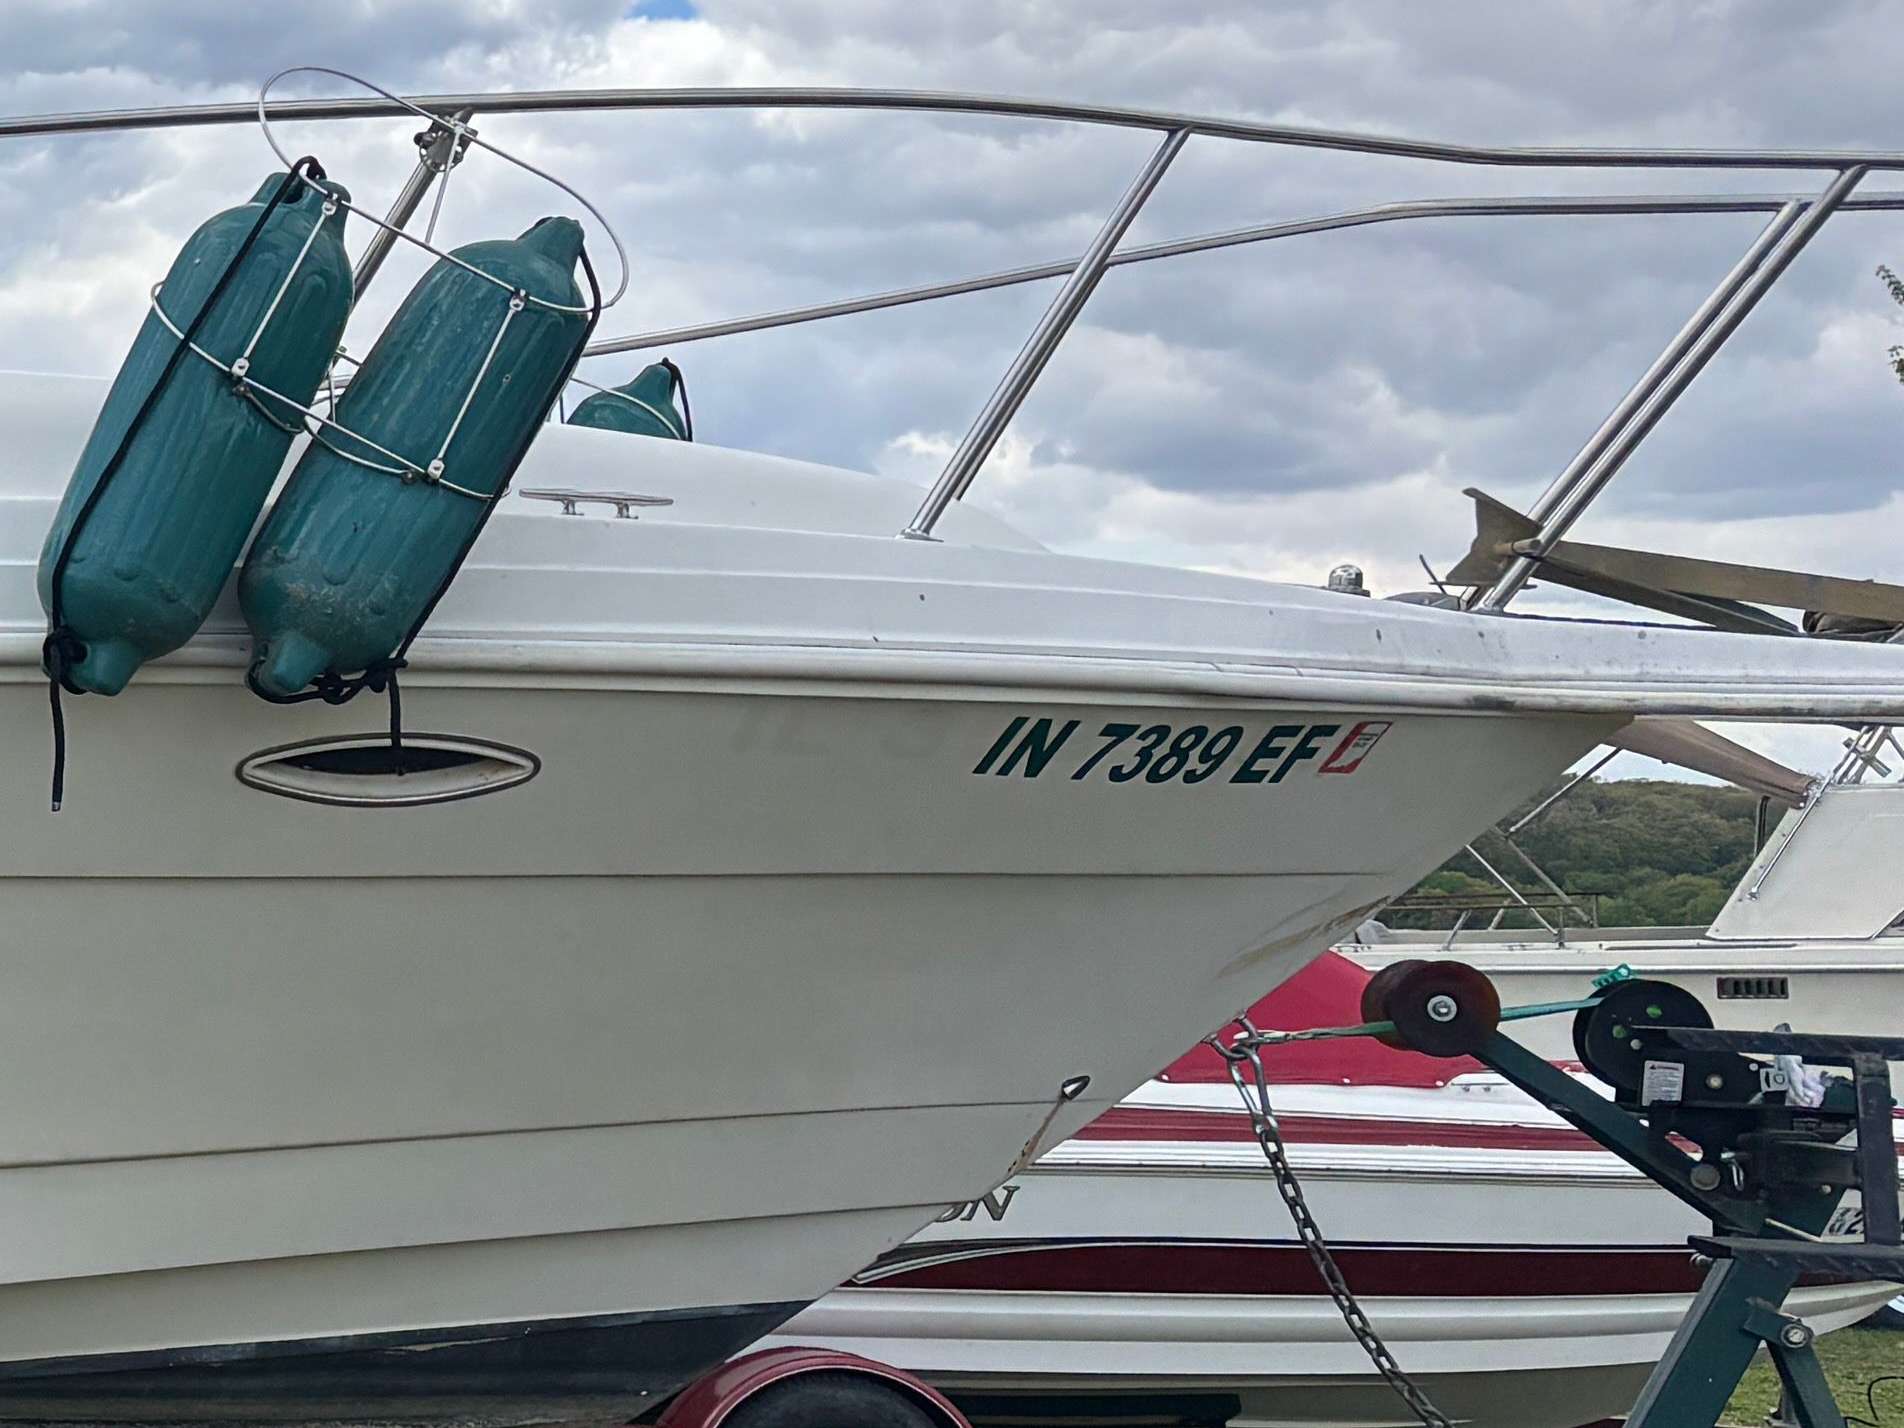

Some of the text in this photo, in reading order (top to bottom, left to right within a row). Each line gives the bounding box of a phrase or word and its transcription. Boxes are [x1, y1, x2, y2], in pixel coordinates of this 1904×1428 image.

[971, 716, 1342, 785] IN 7389 EF
